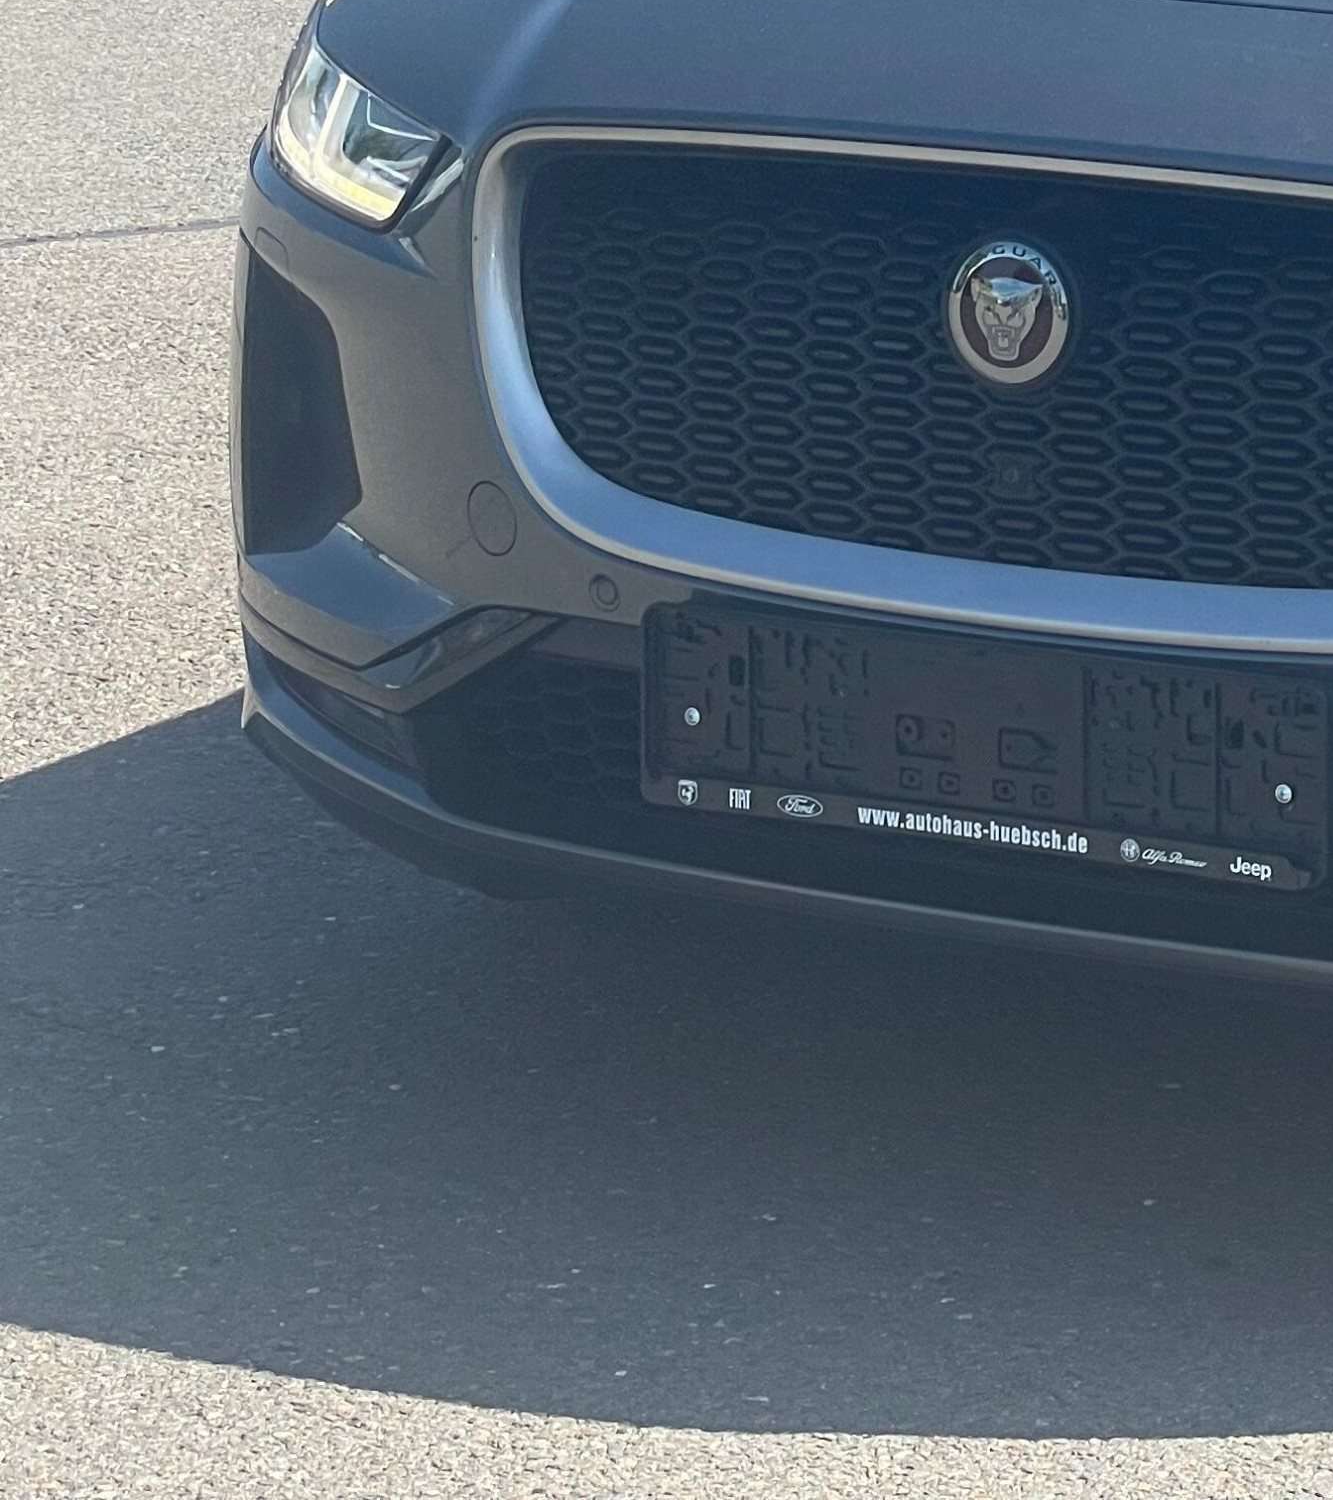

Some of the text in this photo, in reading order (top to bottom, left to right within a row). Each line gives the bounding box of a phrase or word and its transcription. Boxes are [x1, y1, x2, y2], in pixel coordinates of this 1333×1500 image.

[728, 787, 752, 810] FIAT
[783, 797, 817, 815] Ford
[857, 806, 1089, 854] www.autohaus-huebsch.de
[1141, 848, 1168, 866] Alfa
[1229, 856, 1272, 881] Jeep
